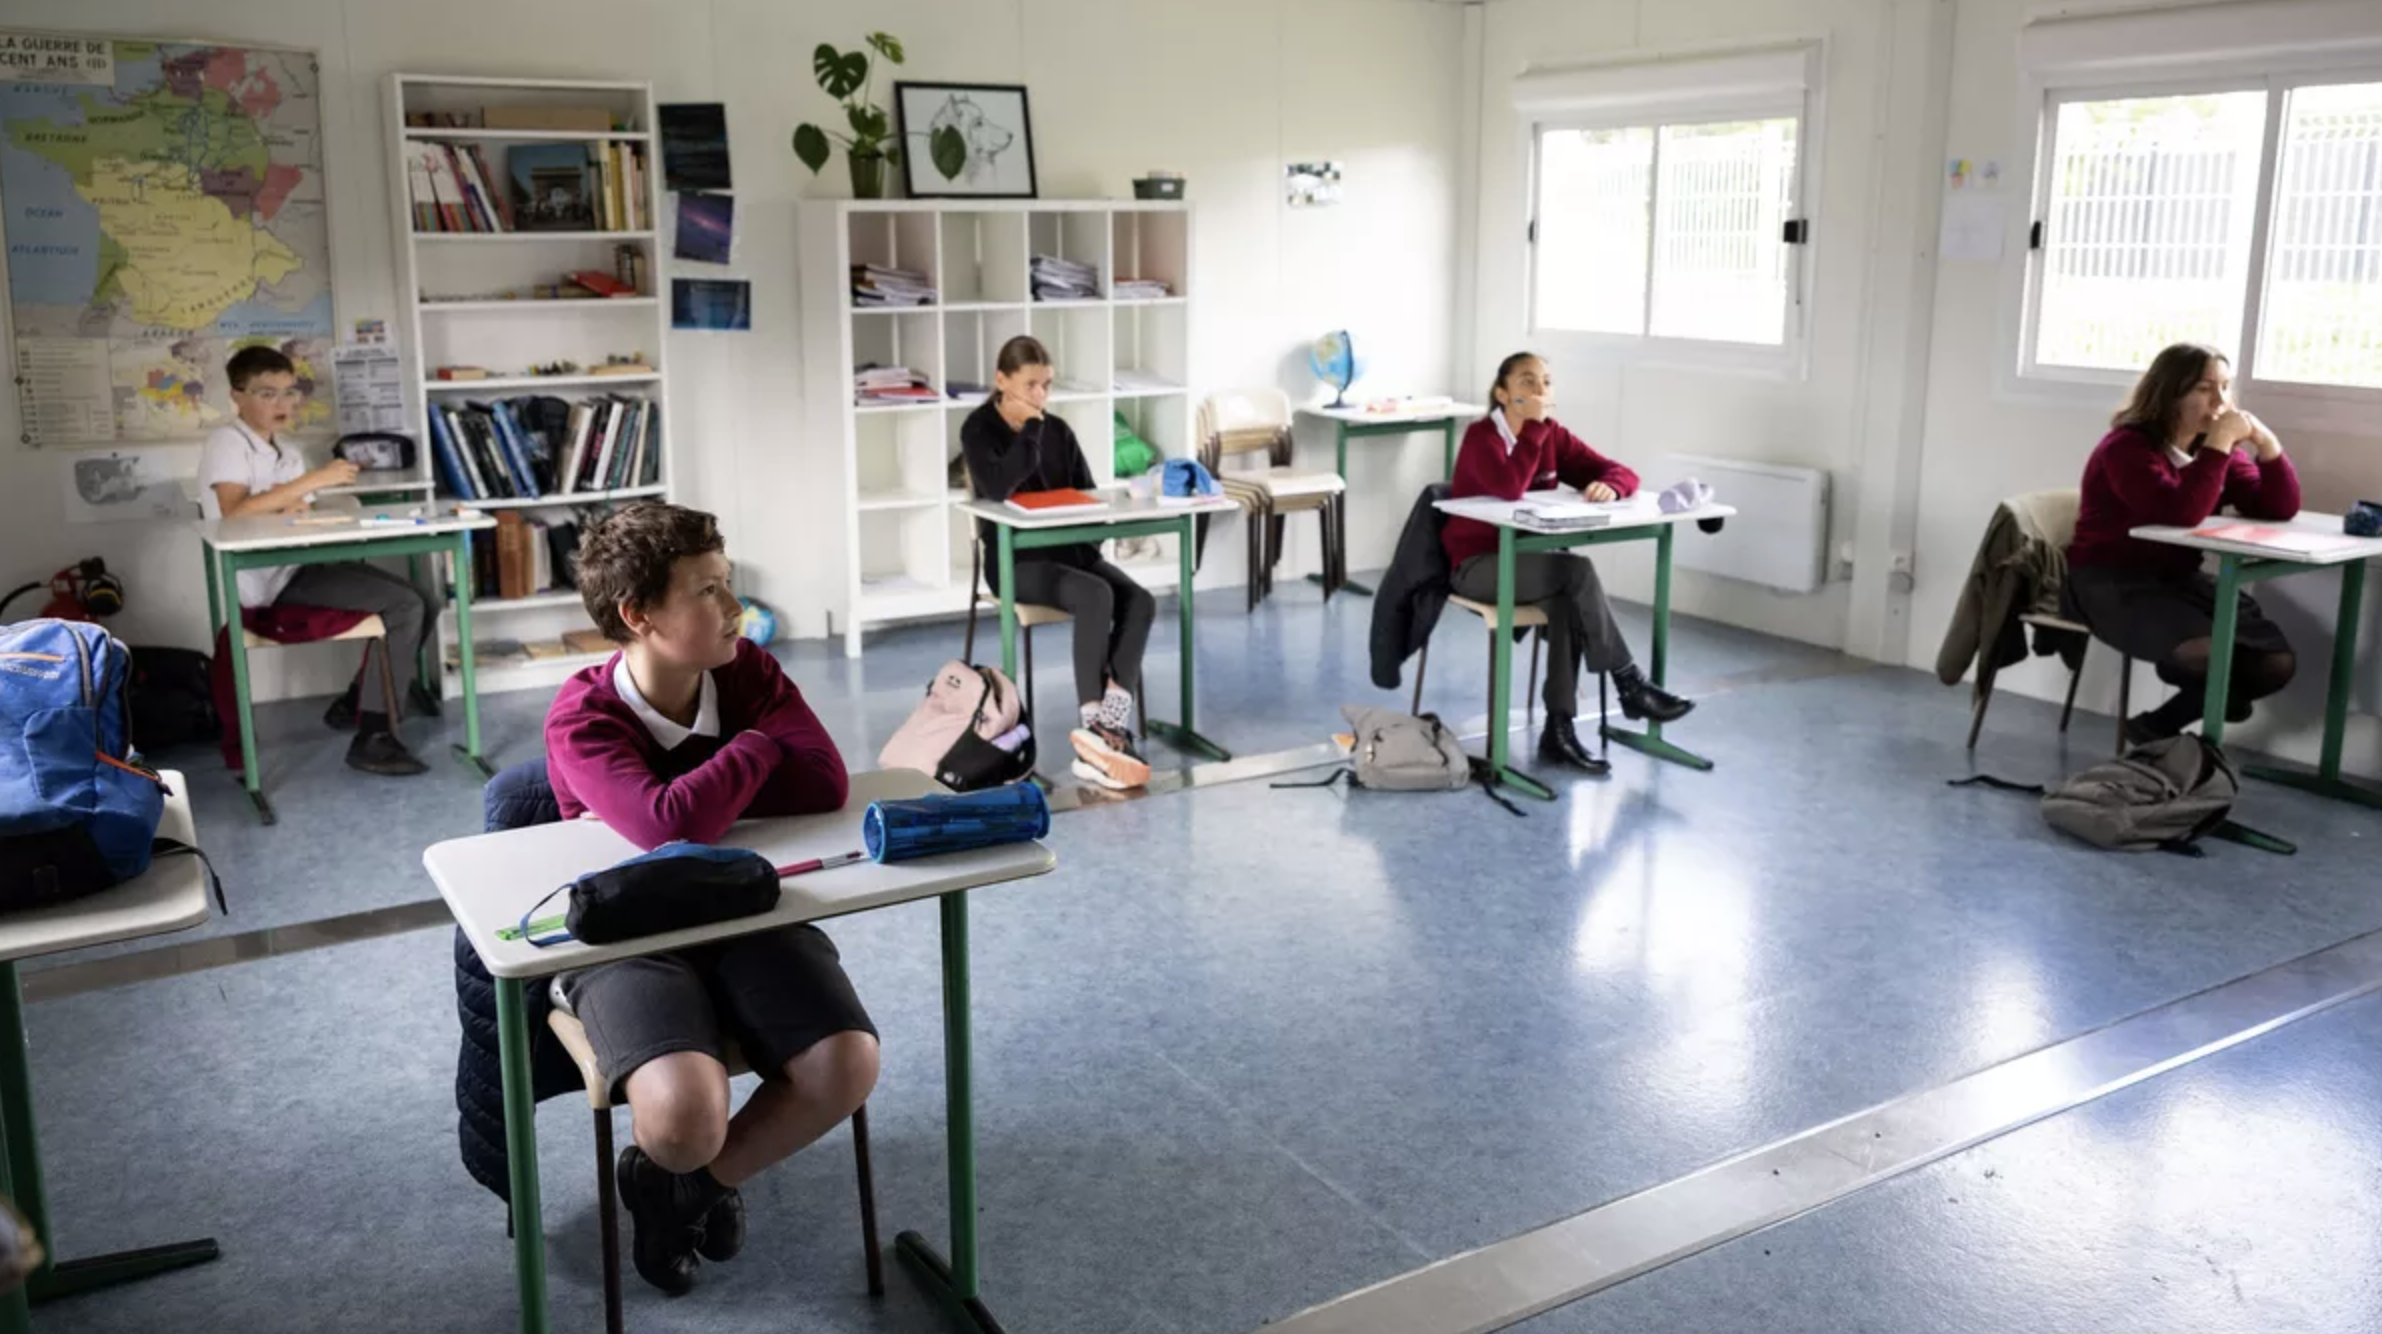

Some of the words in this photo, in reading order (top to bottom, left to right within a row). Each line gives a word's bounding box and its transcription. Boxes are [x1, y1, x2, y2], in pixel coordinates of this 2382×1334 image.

[22, 37, 80, 53] GUERRE
[86, 41, 105, 55] DE
[0, 52, 37, 67] CENT
[46, 54, 79, 69] ANS
